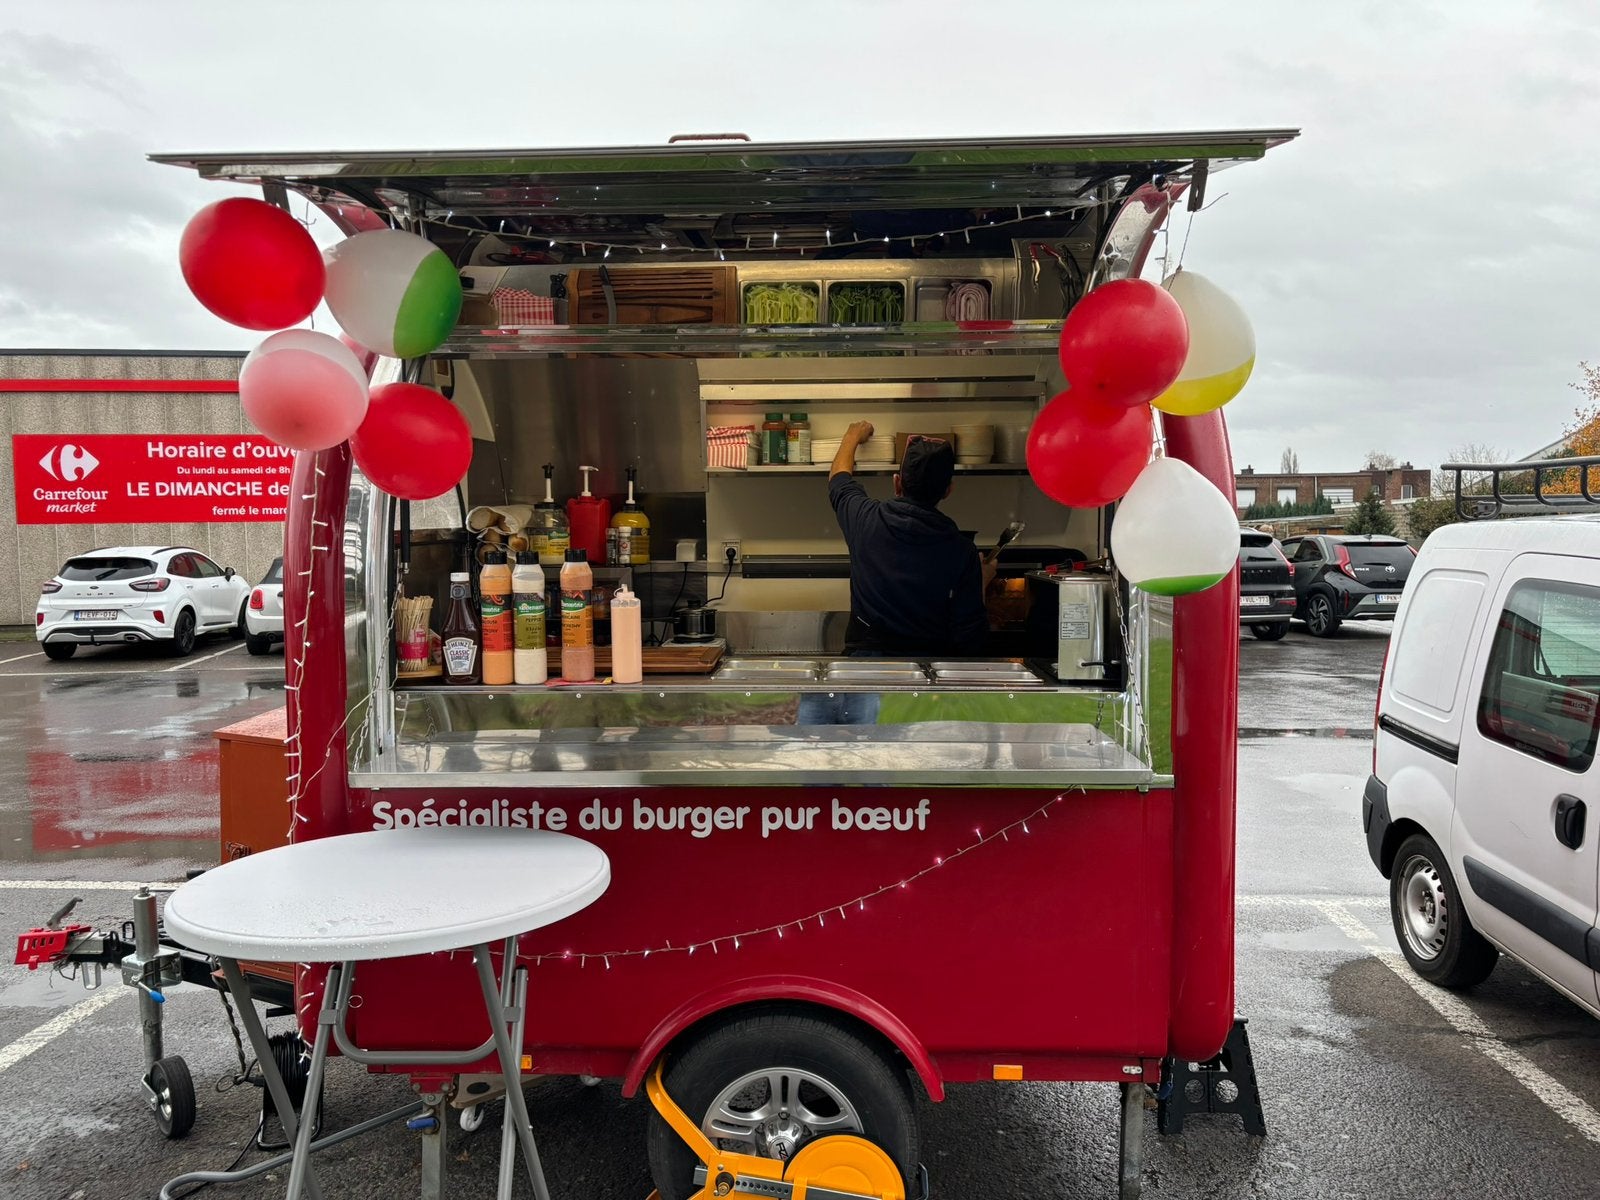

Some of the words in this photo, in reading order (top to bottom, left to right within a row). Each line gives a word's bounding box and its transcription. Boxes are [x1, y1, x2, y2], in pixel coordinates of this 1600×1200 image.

[147, 441, 227, 459] Horaire
[177, 466, 191, 475] Du
[192, 466, 216, 475] lundi
[231, 466, 263, 475] samedi
[265, 466, 277, 475] de
[33, 487, 109, 501] Carrefour
[126, 481, 150, 497] LE
[155, 481, 263, 497] DIMANCHE
[267, 480, 290, 496] de
[46, 501, 97, 514] market
[212, 505, 246, 516] fermé
[249, 506, 260, 515] le
[372, 797, 568, 831] Spécialiste
[578, 797, 623, 831] du
[633, 797, 750, 838] burger
[761, 806, 821, 838] pur
[831, 797, 931, 831] bœuf
